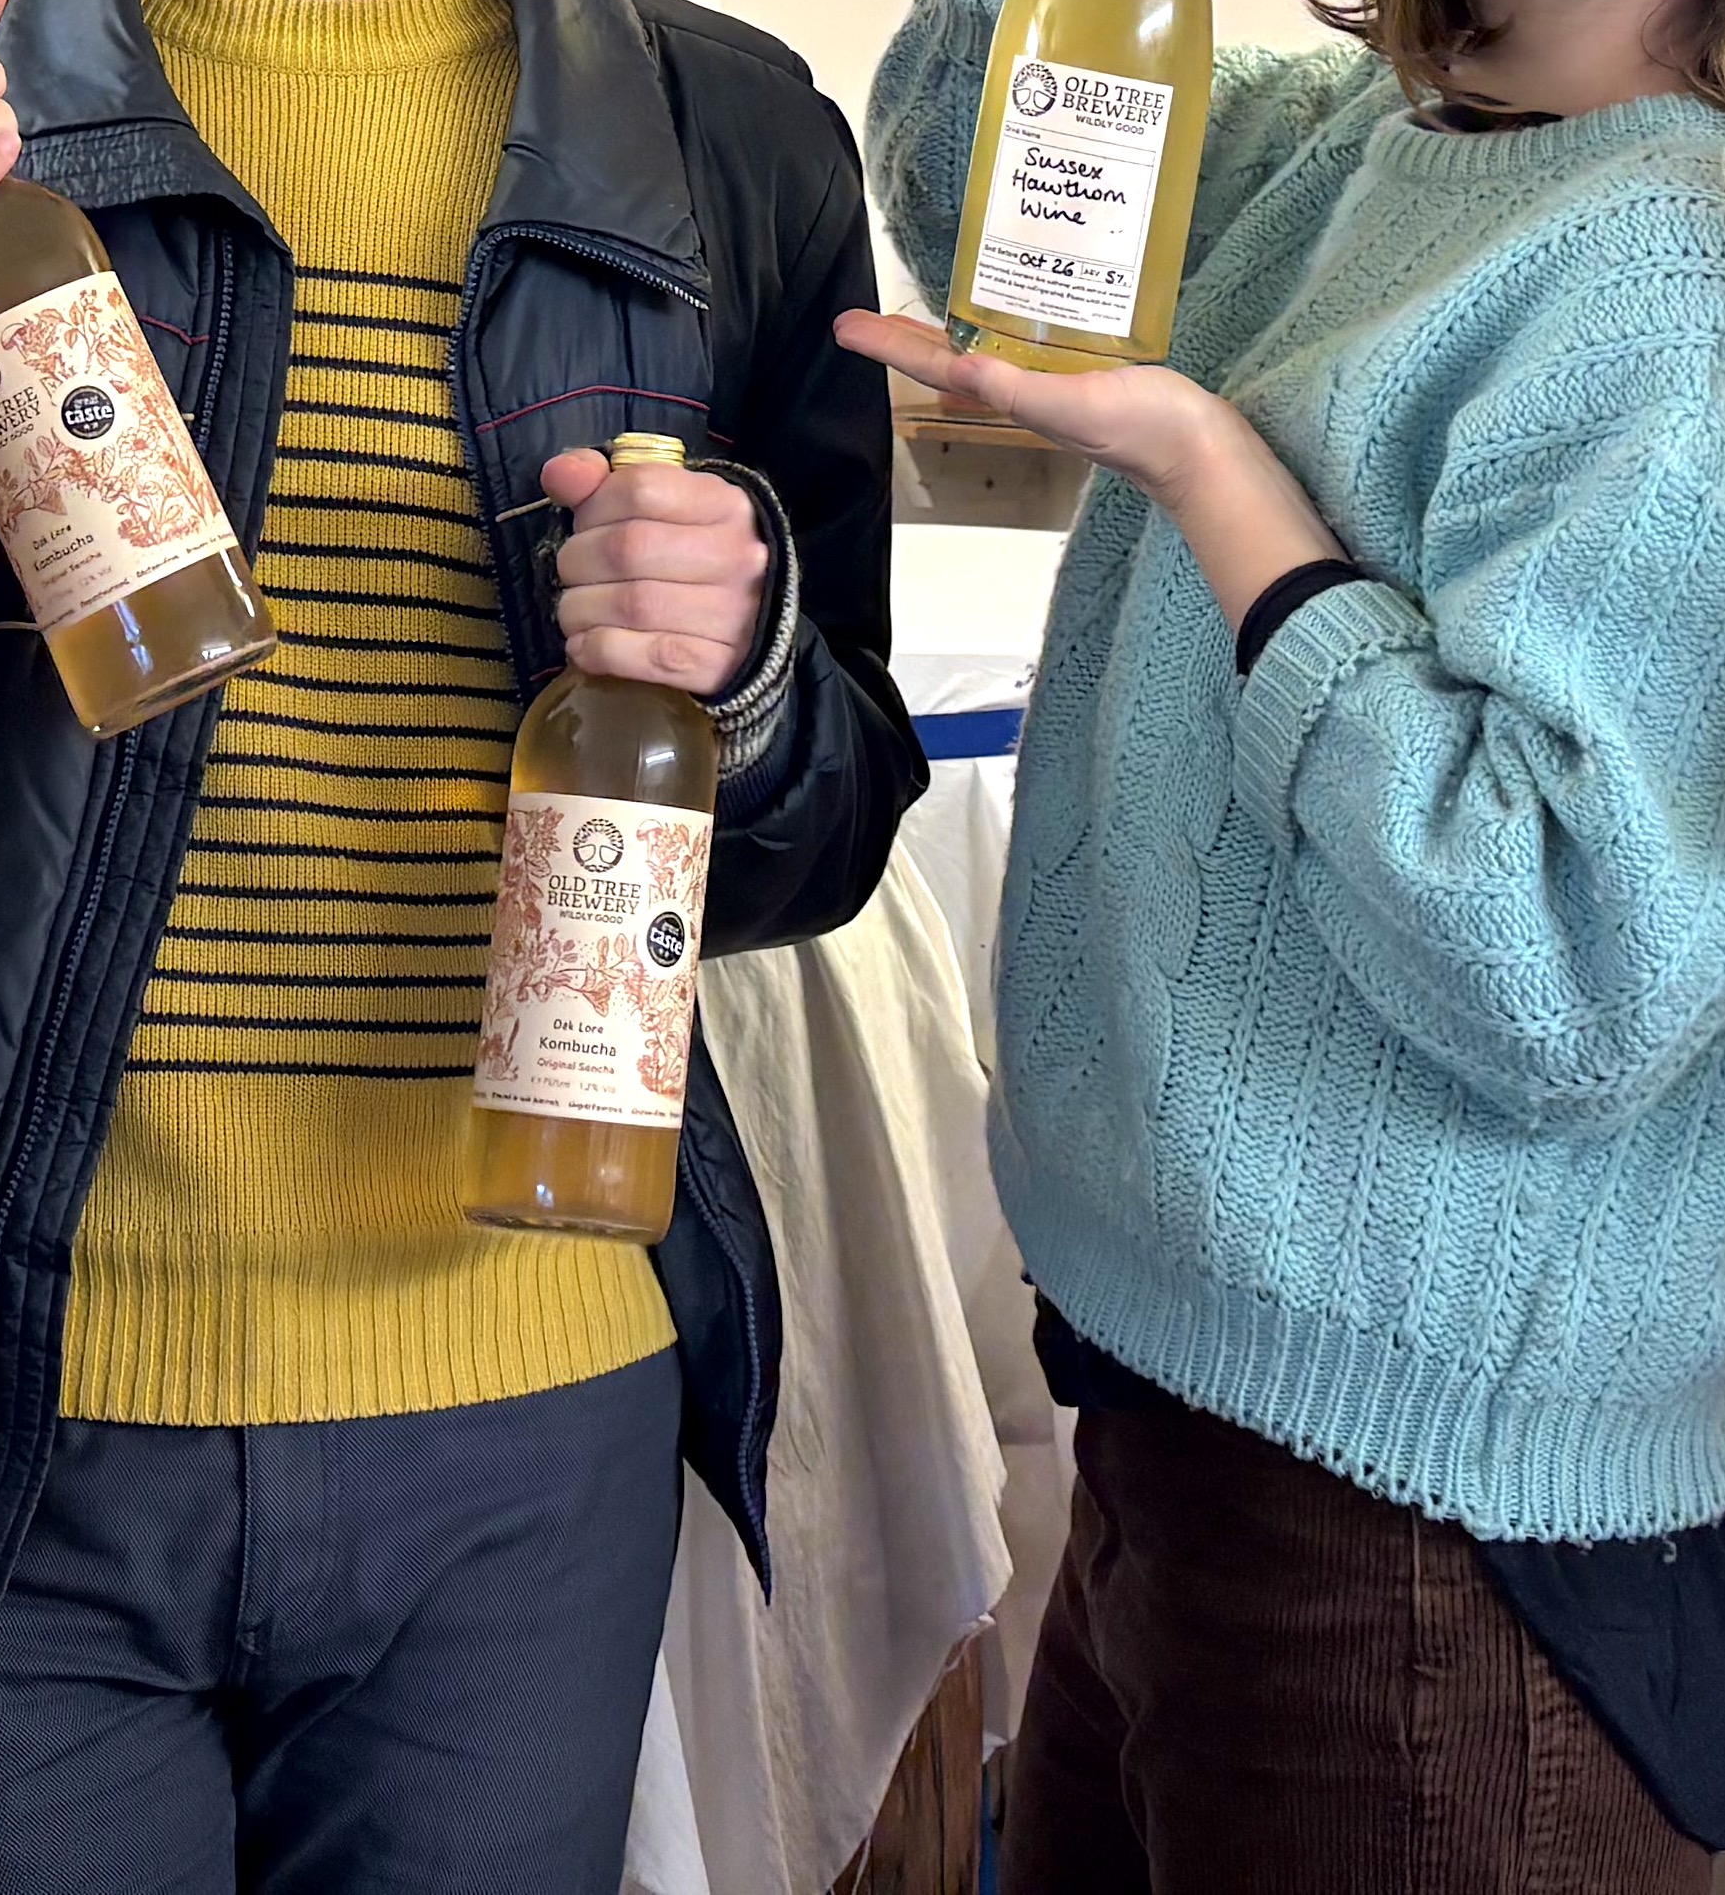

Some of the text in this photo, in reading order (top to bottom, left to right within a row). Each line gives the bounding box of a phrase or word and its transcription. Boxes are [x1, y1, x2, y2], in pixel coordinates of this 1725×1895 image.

[1064, 76, 1166, 110] OLD TREE
[1061, 92, 1163, 126] BREWERY
[1075, 114, 1145, 136] WILDLY GOOD
[1024, 146, 1104, 180] Sussex
[1020, 197, 1087, 226] Wine
[1051, 257, 1075, 277] 26
[64, 405, 114, 426] taste
[548, 874, 642, 899] OLD TREE
[546, 890, 640, 915] BREWERY
[650, 926, 683, 956] taste
[578, 1021, 604, 1034] Lore
[538, 1036, 617, 1057] Kombucha
